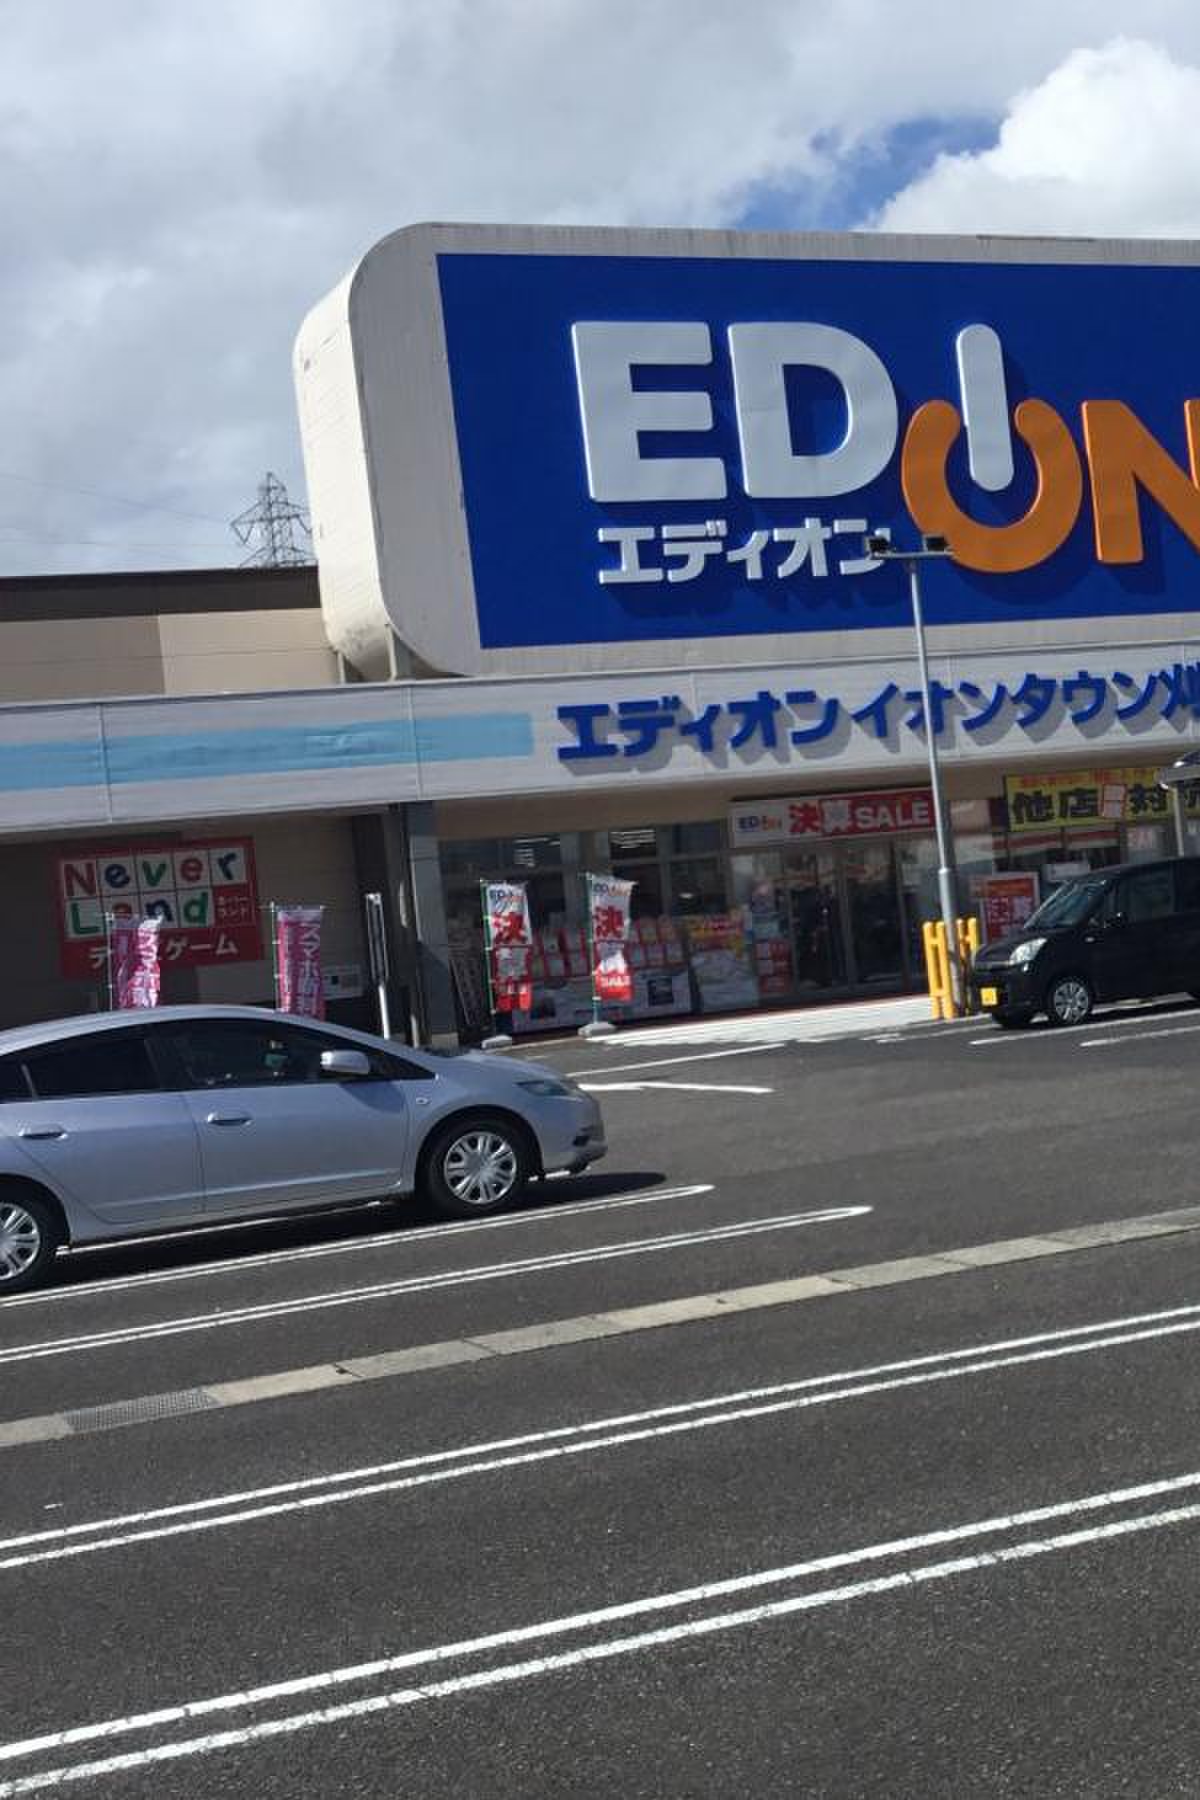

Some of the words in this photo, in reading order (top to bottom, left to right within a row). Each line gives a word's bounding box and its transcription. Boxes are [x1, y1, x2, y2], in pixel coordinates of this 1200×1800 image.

[597, 517, 891, 584] エディオン
[63, 849, 237, 898] Never
